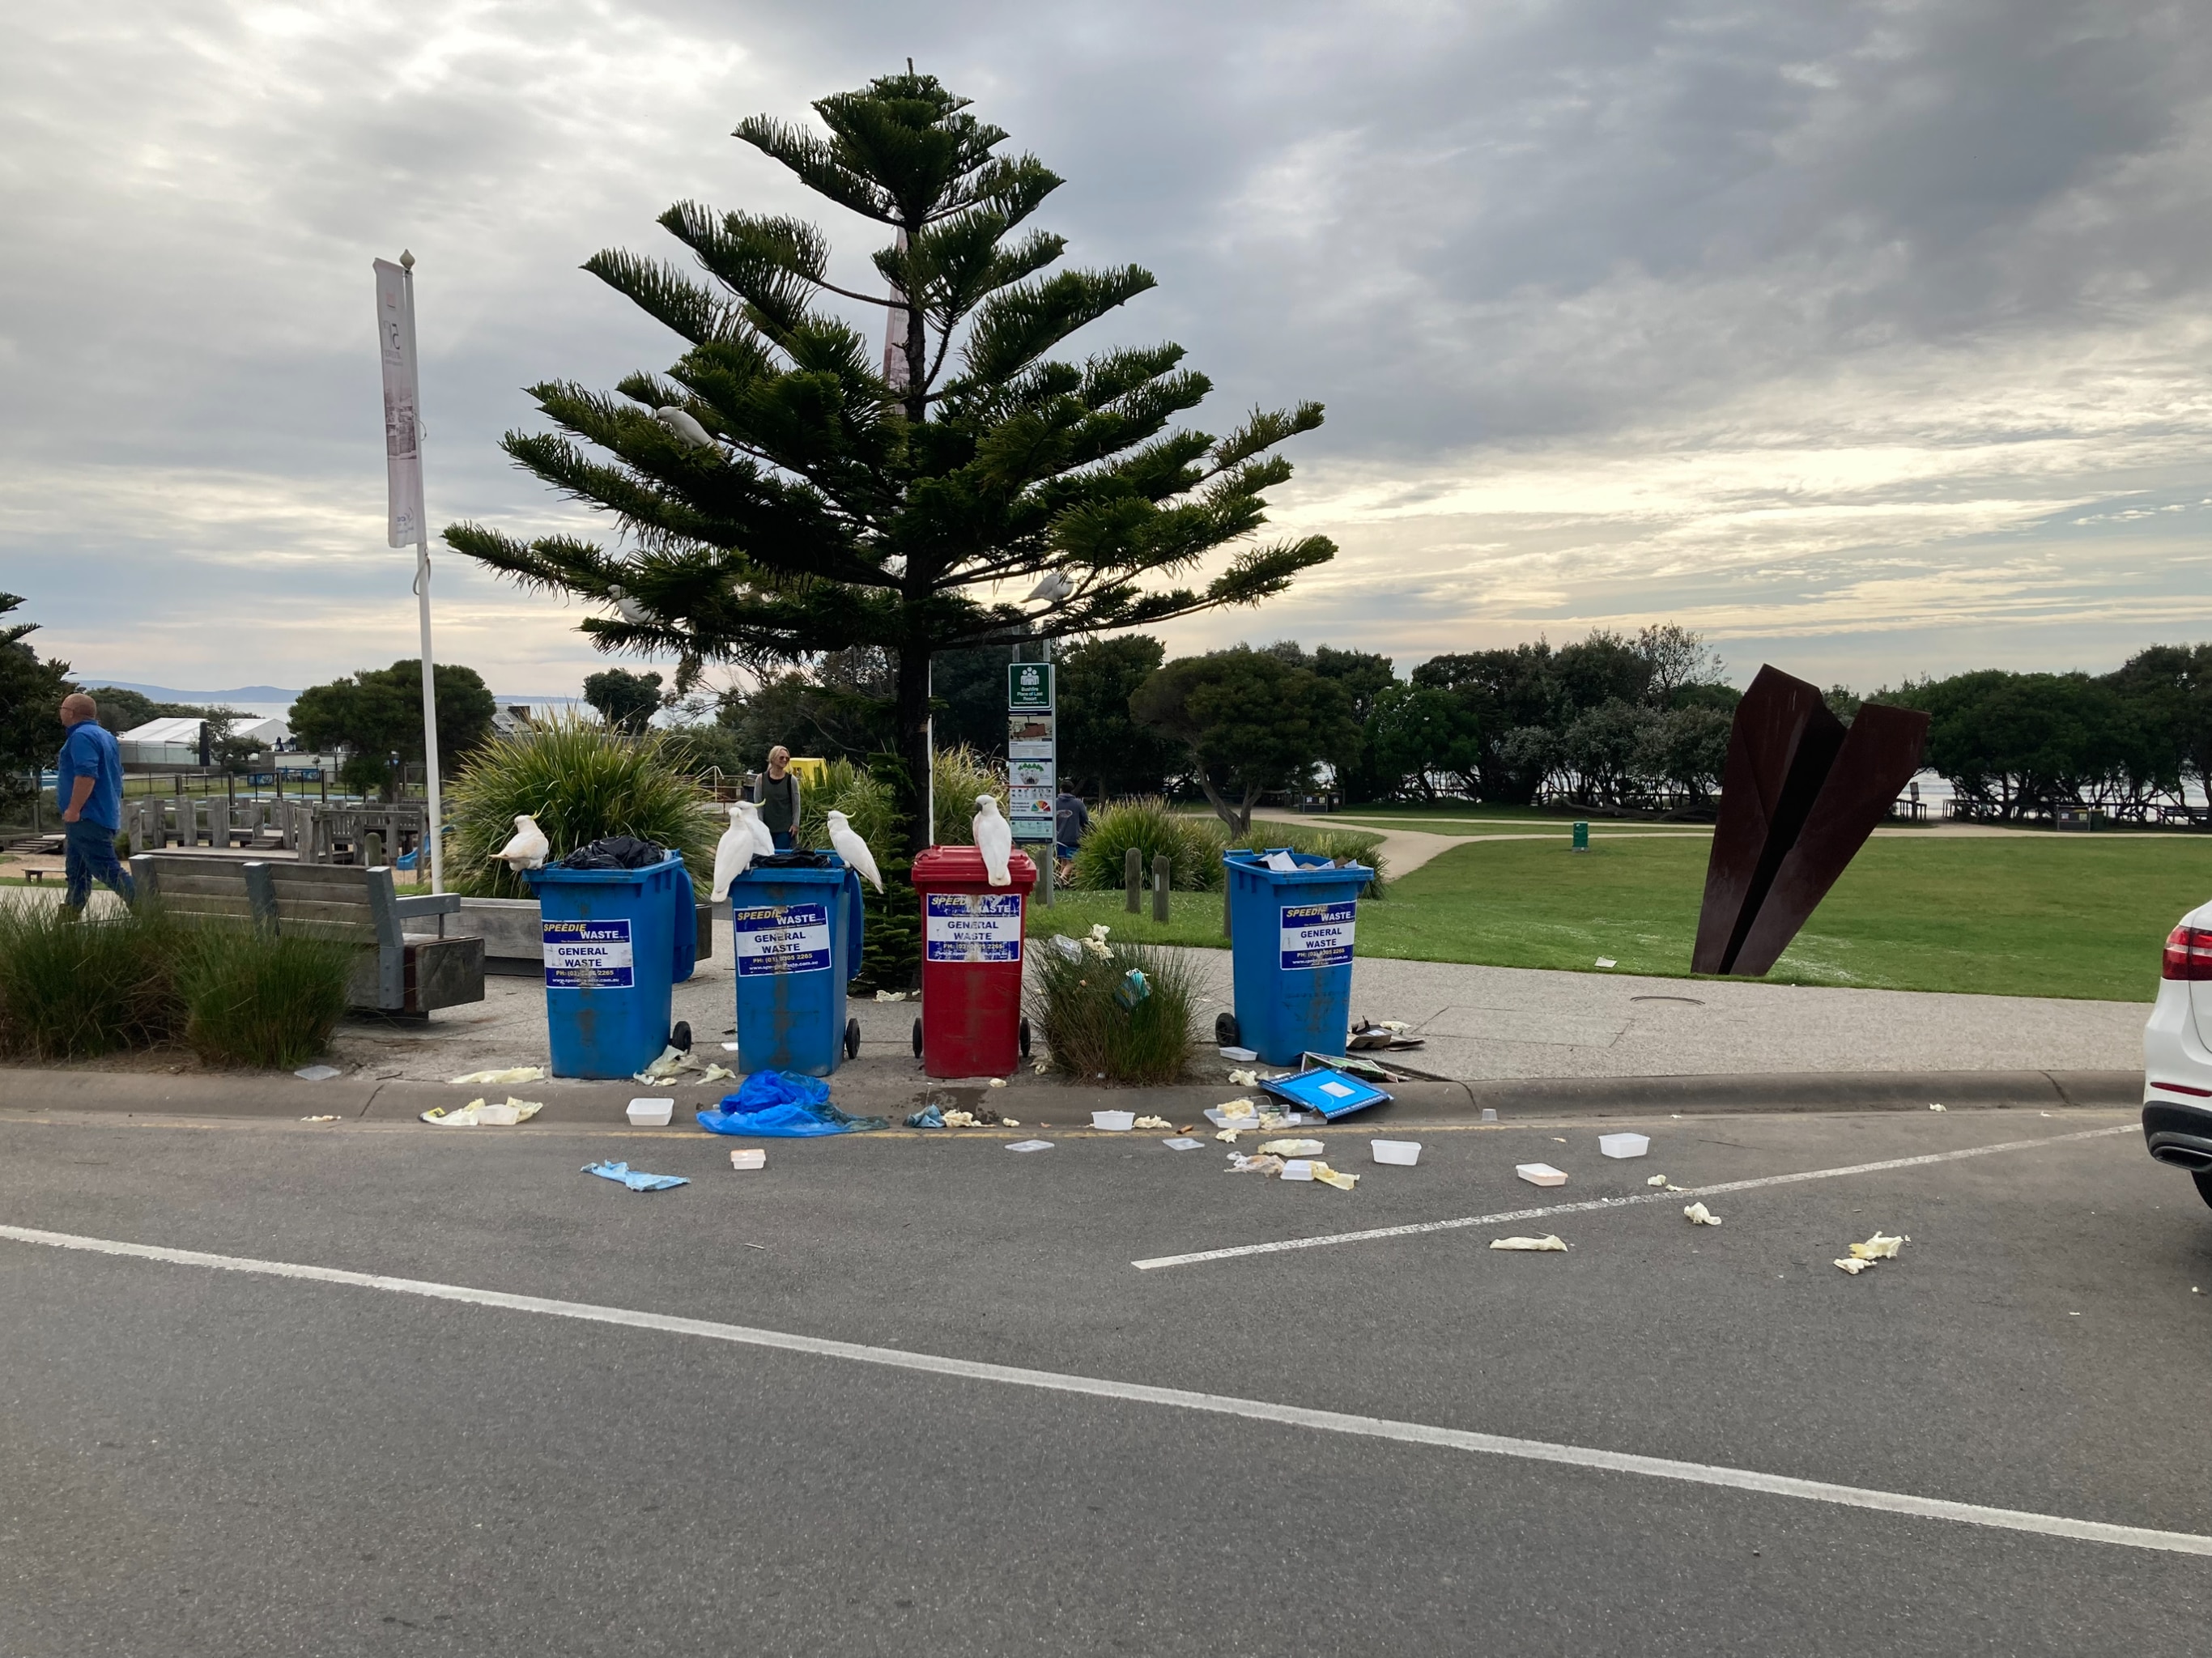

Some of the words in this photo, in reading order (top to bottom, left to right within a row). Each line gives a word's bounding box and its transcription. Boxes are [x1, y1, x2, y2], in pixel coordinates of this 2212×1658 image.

[777, 914, 816, 925] WASTE
[1320, 911, 1351, 922] WASTE
[544, 924, 587, 932] SPEEDIE
[1301, 928, 1342, 938] GENERAL
[580, 931, 619, 939] WASTE
[754, 932, 806, 943] GENERAL
[762, 943, 800, 954] WASTE
[1306, 939, 1337, 948] WASTE
[565, 959, 602, 967] WASTE
